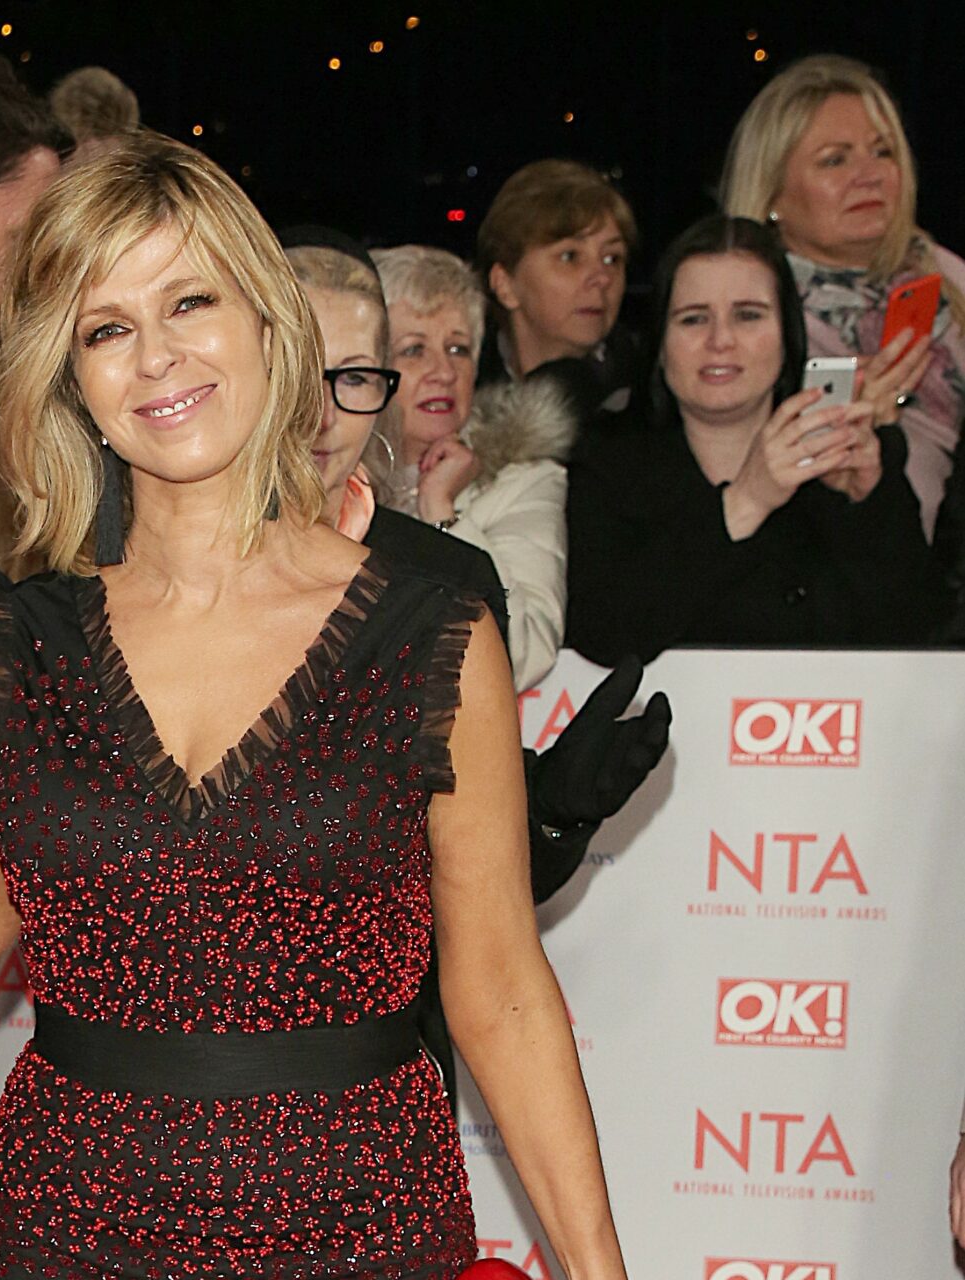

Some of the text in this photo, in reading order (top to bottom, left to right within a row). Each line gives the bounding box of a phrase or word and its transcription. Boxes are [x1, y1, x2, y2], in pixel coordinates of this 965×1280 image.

[517, 688, 577, 748] TA
[734, 701, 856, 755] OK!
[708, 829, 869, 896] NTA
[686, 903, 887, 921] NATIONAL TELEVISION AWARDS
[720, 981, 844, 1037] OK!
[694, 1108, 856, 1177] NTA
[673, 1181, 876, 1203] NATIONAL TELEVISION AWARDS
